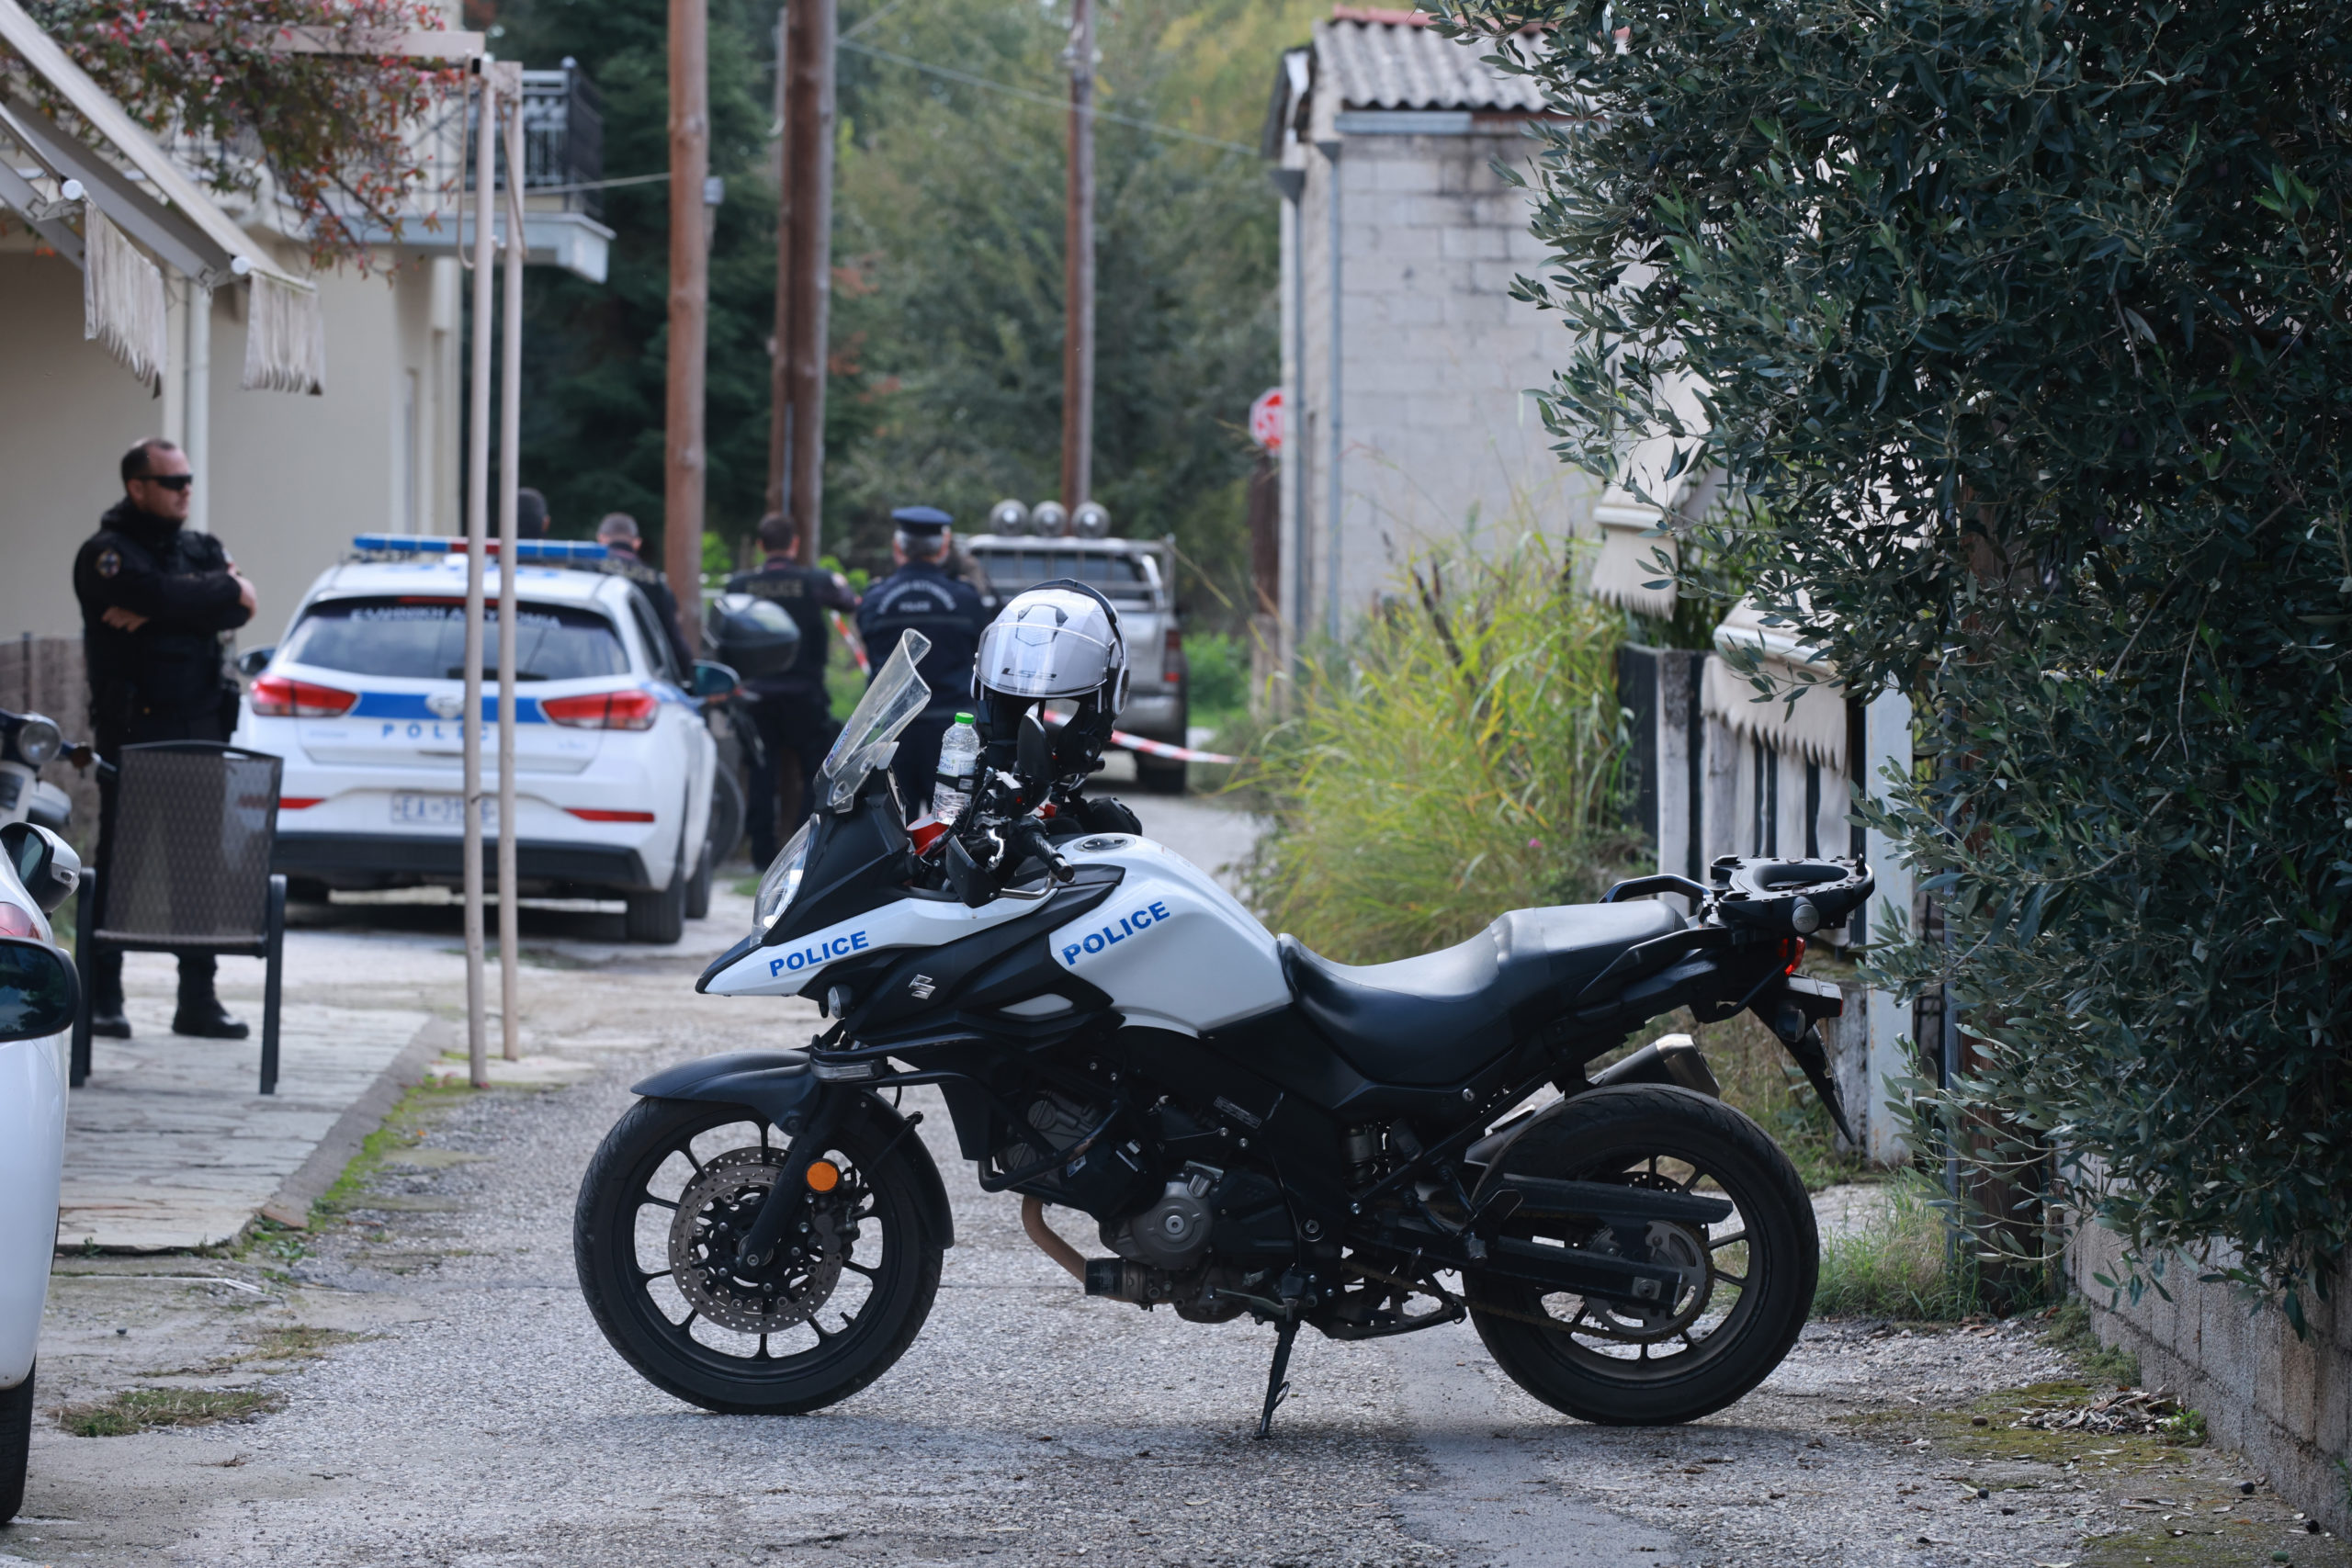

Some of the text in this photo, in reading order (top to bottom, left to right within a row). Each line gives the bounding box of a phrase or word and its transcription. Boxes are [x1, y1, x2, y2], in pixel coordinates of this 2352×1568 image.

[382, 722, 490, 740] POLIC
[769, 931, 869, 977] POLICE
[1061, 901, 1170, 965] POLICE
